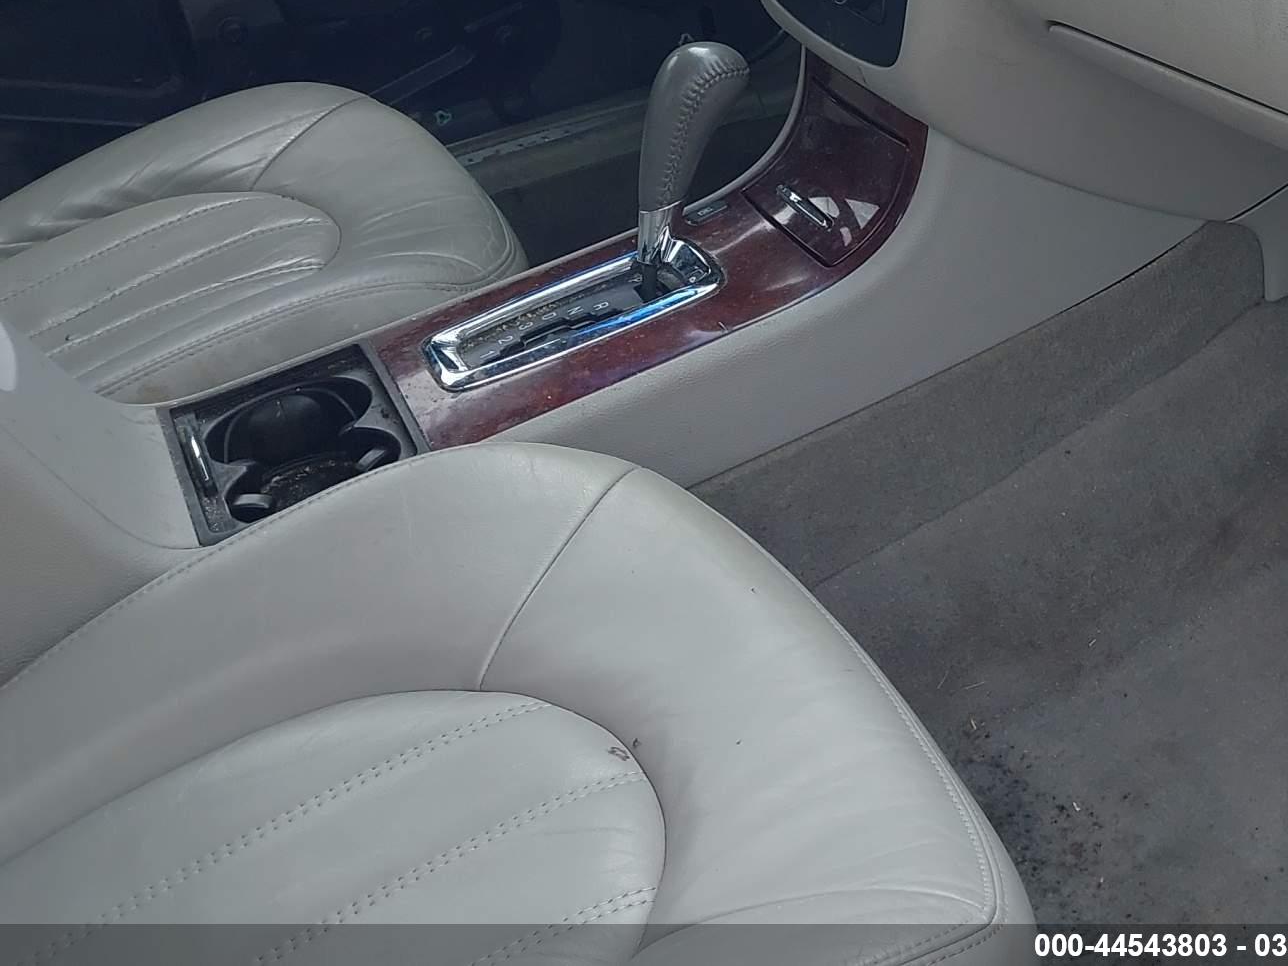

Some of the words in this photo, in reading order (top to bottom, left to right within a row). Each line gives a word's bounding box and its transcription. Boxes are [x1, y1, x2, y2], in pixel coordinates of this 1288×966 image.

[593, 301, 609, 311] R
[518, 321, 534, 331] 3
[498, 335, 513, 345] 2
[480, 350, 495, 359] 1
